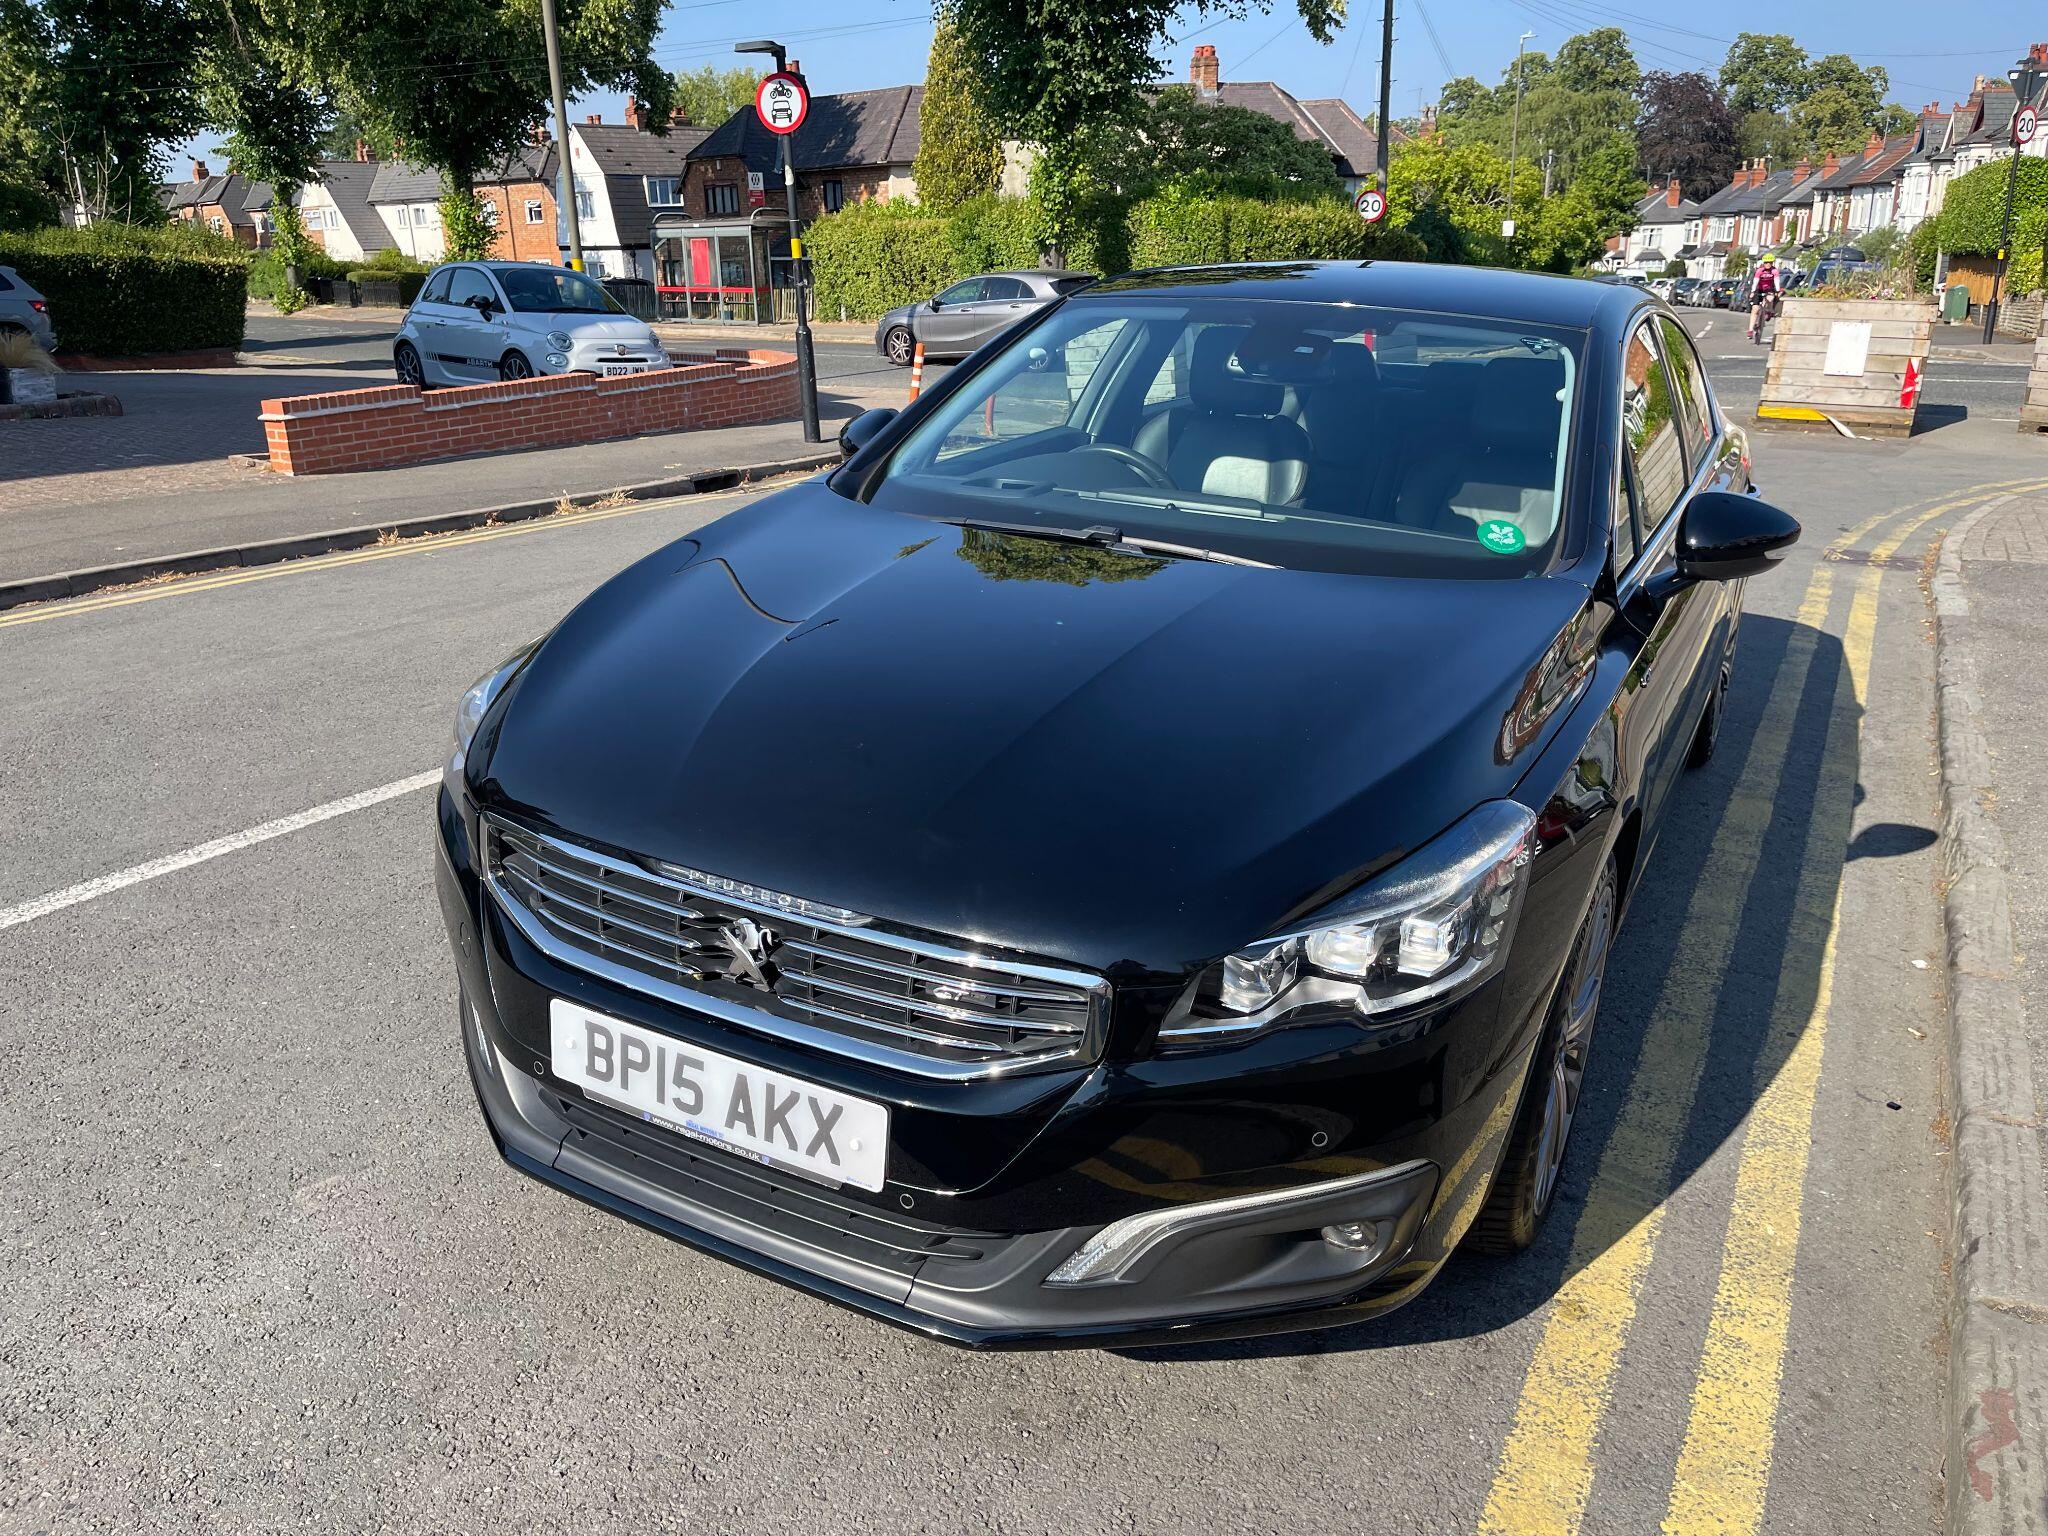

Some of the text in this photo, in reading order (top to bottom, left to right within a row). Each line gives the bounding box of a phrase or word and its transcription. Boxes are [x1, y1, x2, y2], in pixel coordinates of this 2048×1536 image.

[2018, 118, 2034, 133] 20
[1360, 200, 1380, 212] 20
[606, 366, 628, 376] BD22
[689, 869, 812, 911] PEUGEOT
[933, 985, 970, 1001] GT
[584, 1019, 844, 1167] BP15 AKX
[652, 1116, 760, 1162] www.regal-motors.co.uk
